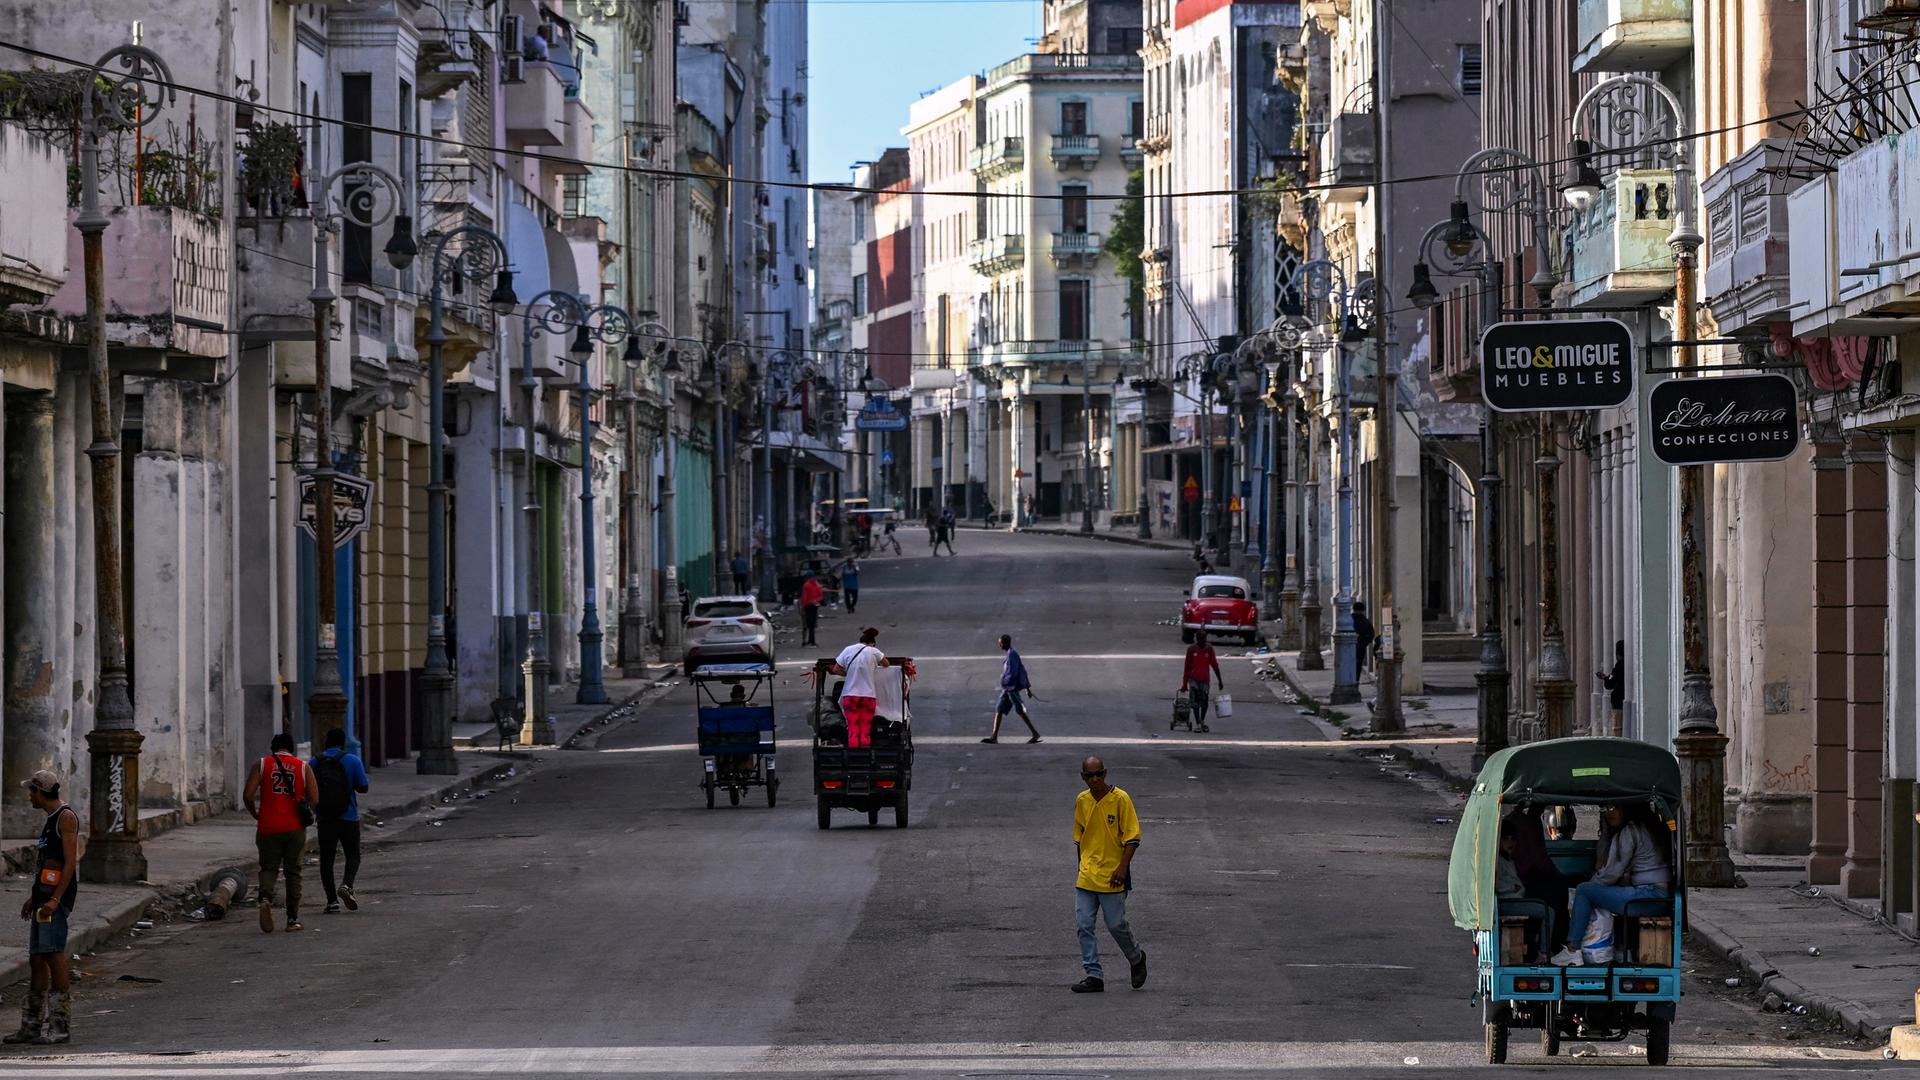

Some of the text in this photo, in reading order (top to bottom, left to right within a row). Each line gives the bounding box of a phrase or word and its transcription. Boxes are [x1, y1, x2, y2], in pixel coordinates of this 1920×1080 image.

[1495, 343, 1620, 369] LEO&MIGUE
[1495, 371, 1621, 388] MUEBLES
[1660, 397, 1788, 431] Lohana
[1661, 430, 1790, 447] CONFECCIONES
